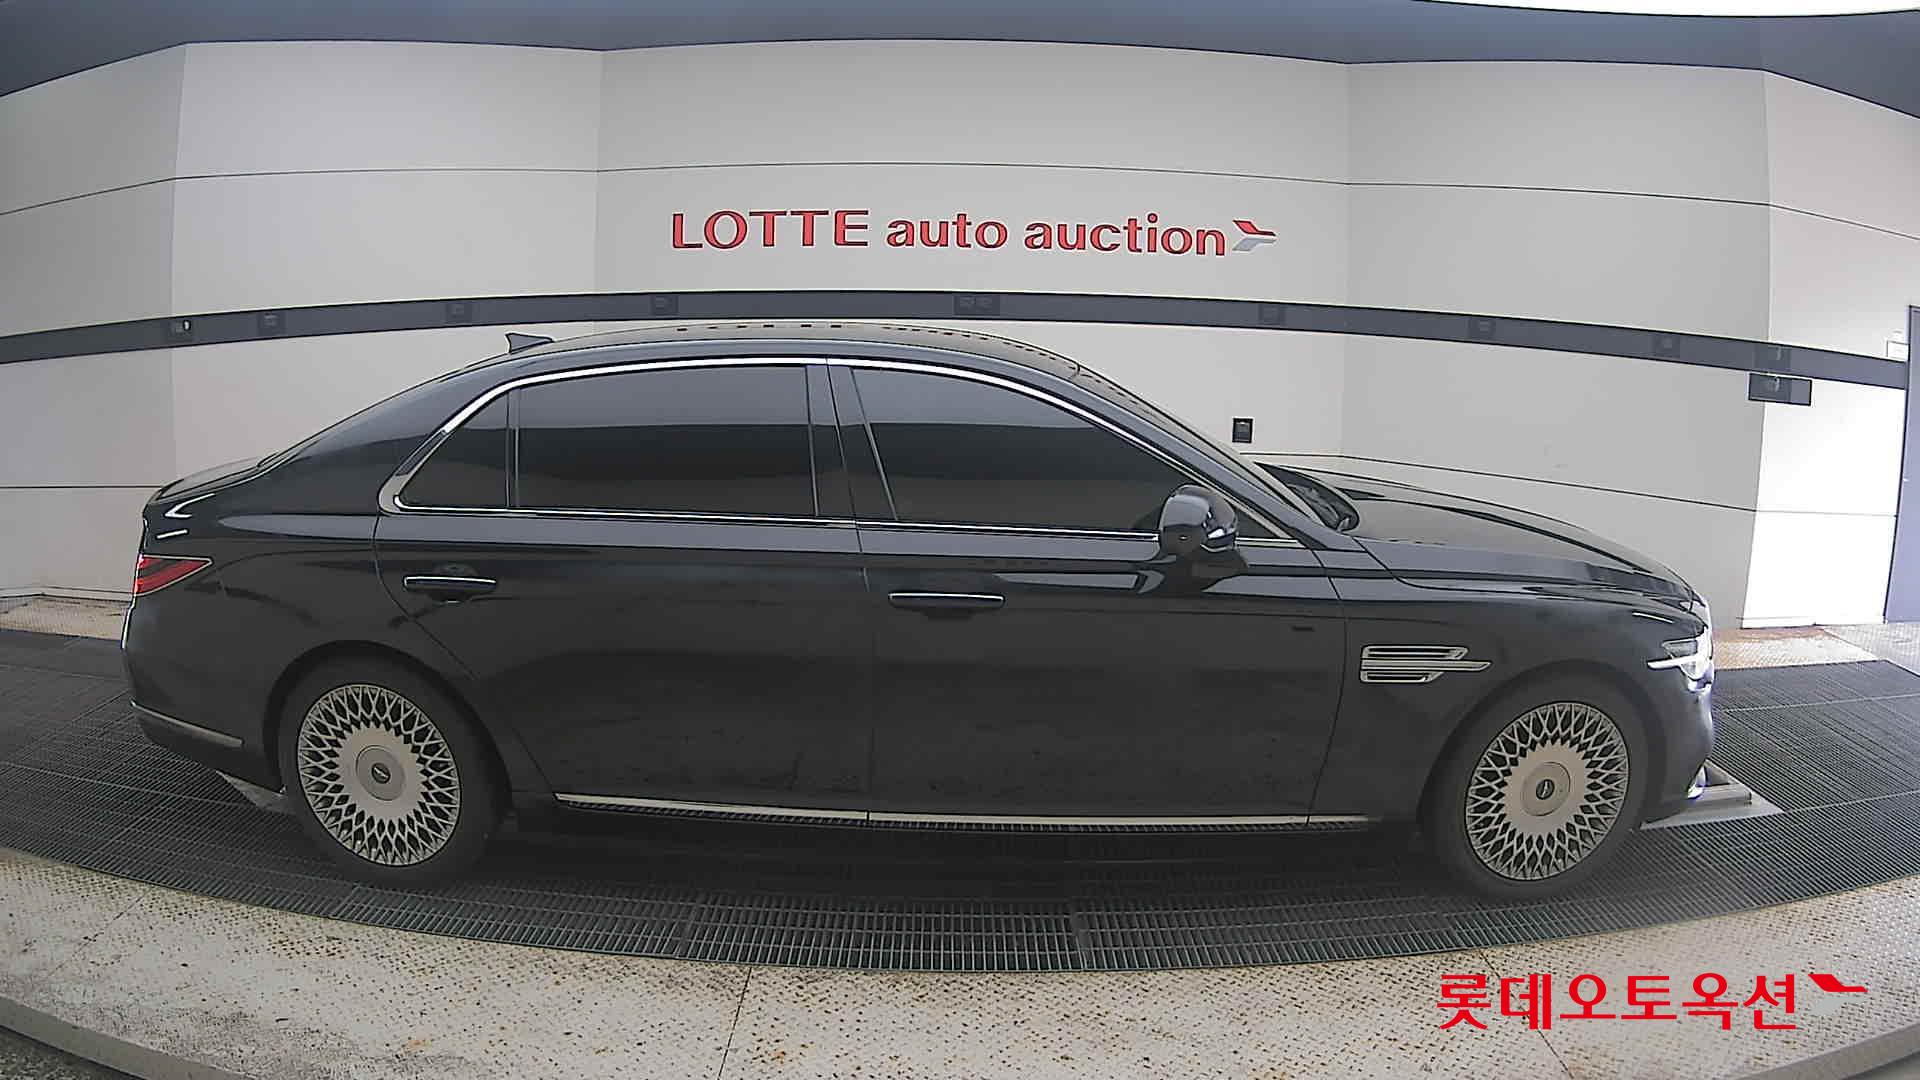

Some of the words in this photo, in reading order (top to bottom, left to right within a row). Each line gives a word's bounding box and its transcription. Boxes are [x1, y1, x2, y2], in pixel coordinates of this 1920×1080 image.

[671, 210, 869, 249] LOTTE
[886, 213, 1008, 249] auto
[1024, 213, 1227, 257] auction
